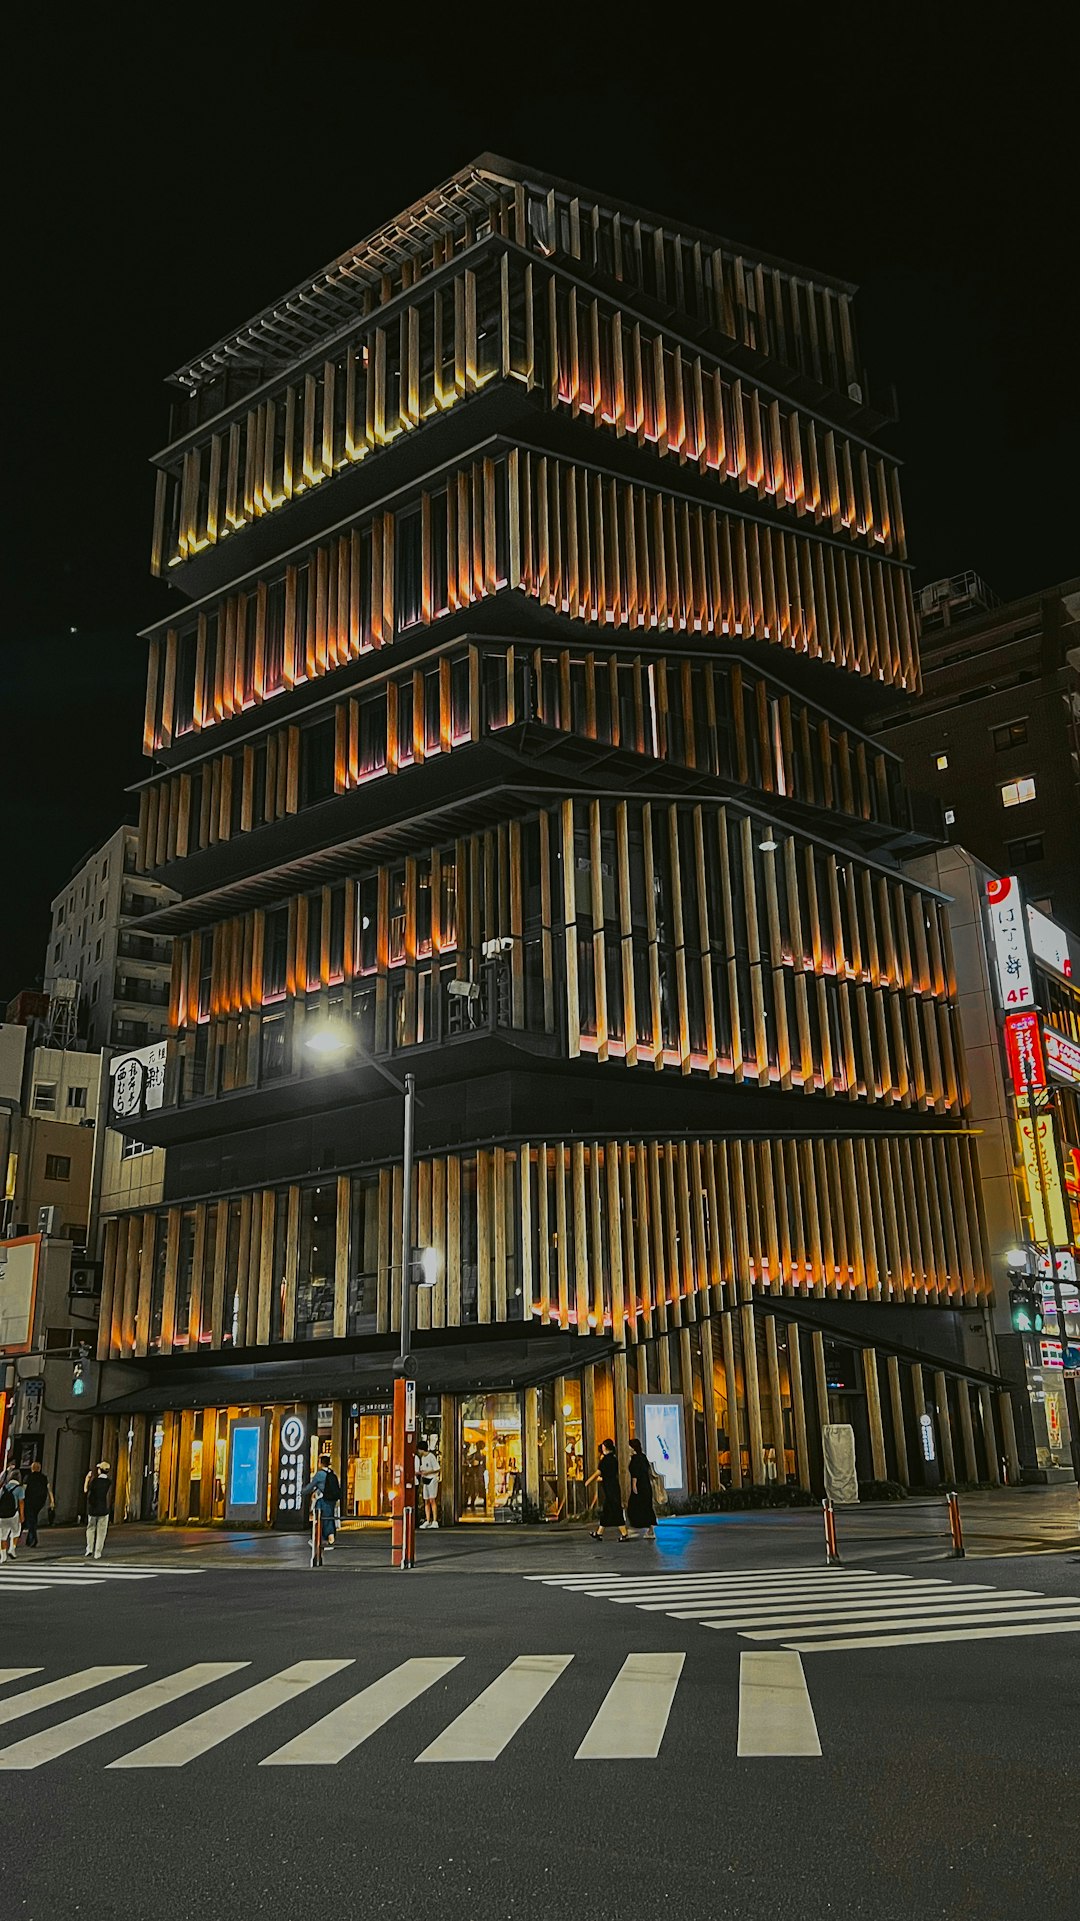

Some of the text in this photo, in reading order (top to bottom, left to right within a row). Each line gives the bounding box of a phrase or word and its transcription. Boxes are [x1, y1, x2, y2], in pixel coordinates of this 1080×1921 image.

[1007, 986, 1029, 1003] 4F
[117, 1067, 127, 1112] 西むら
[1023, 1121, 1058, 1191] Denny's
